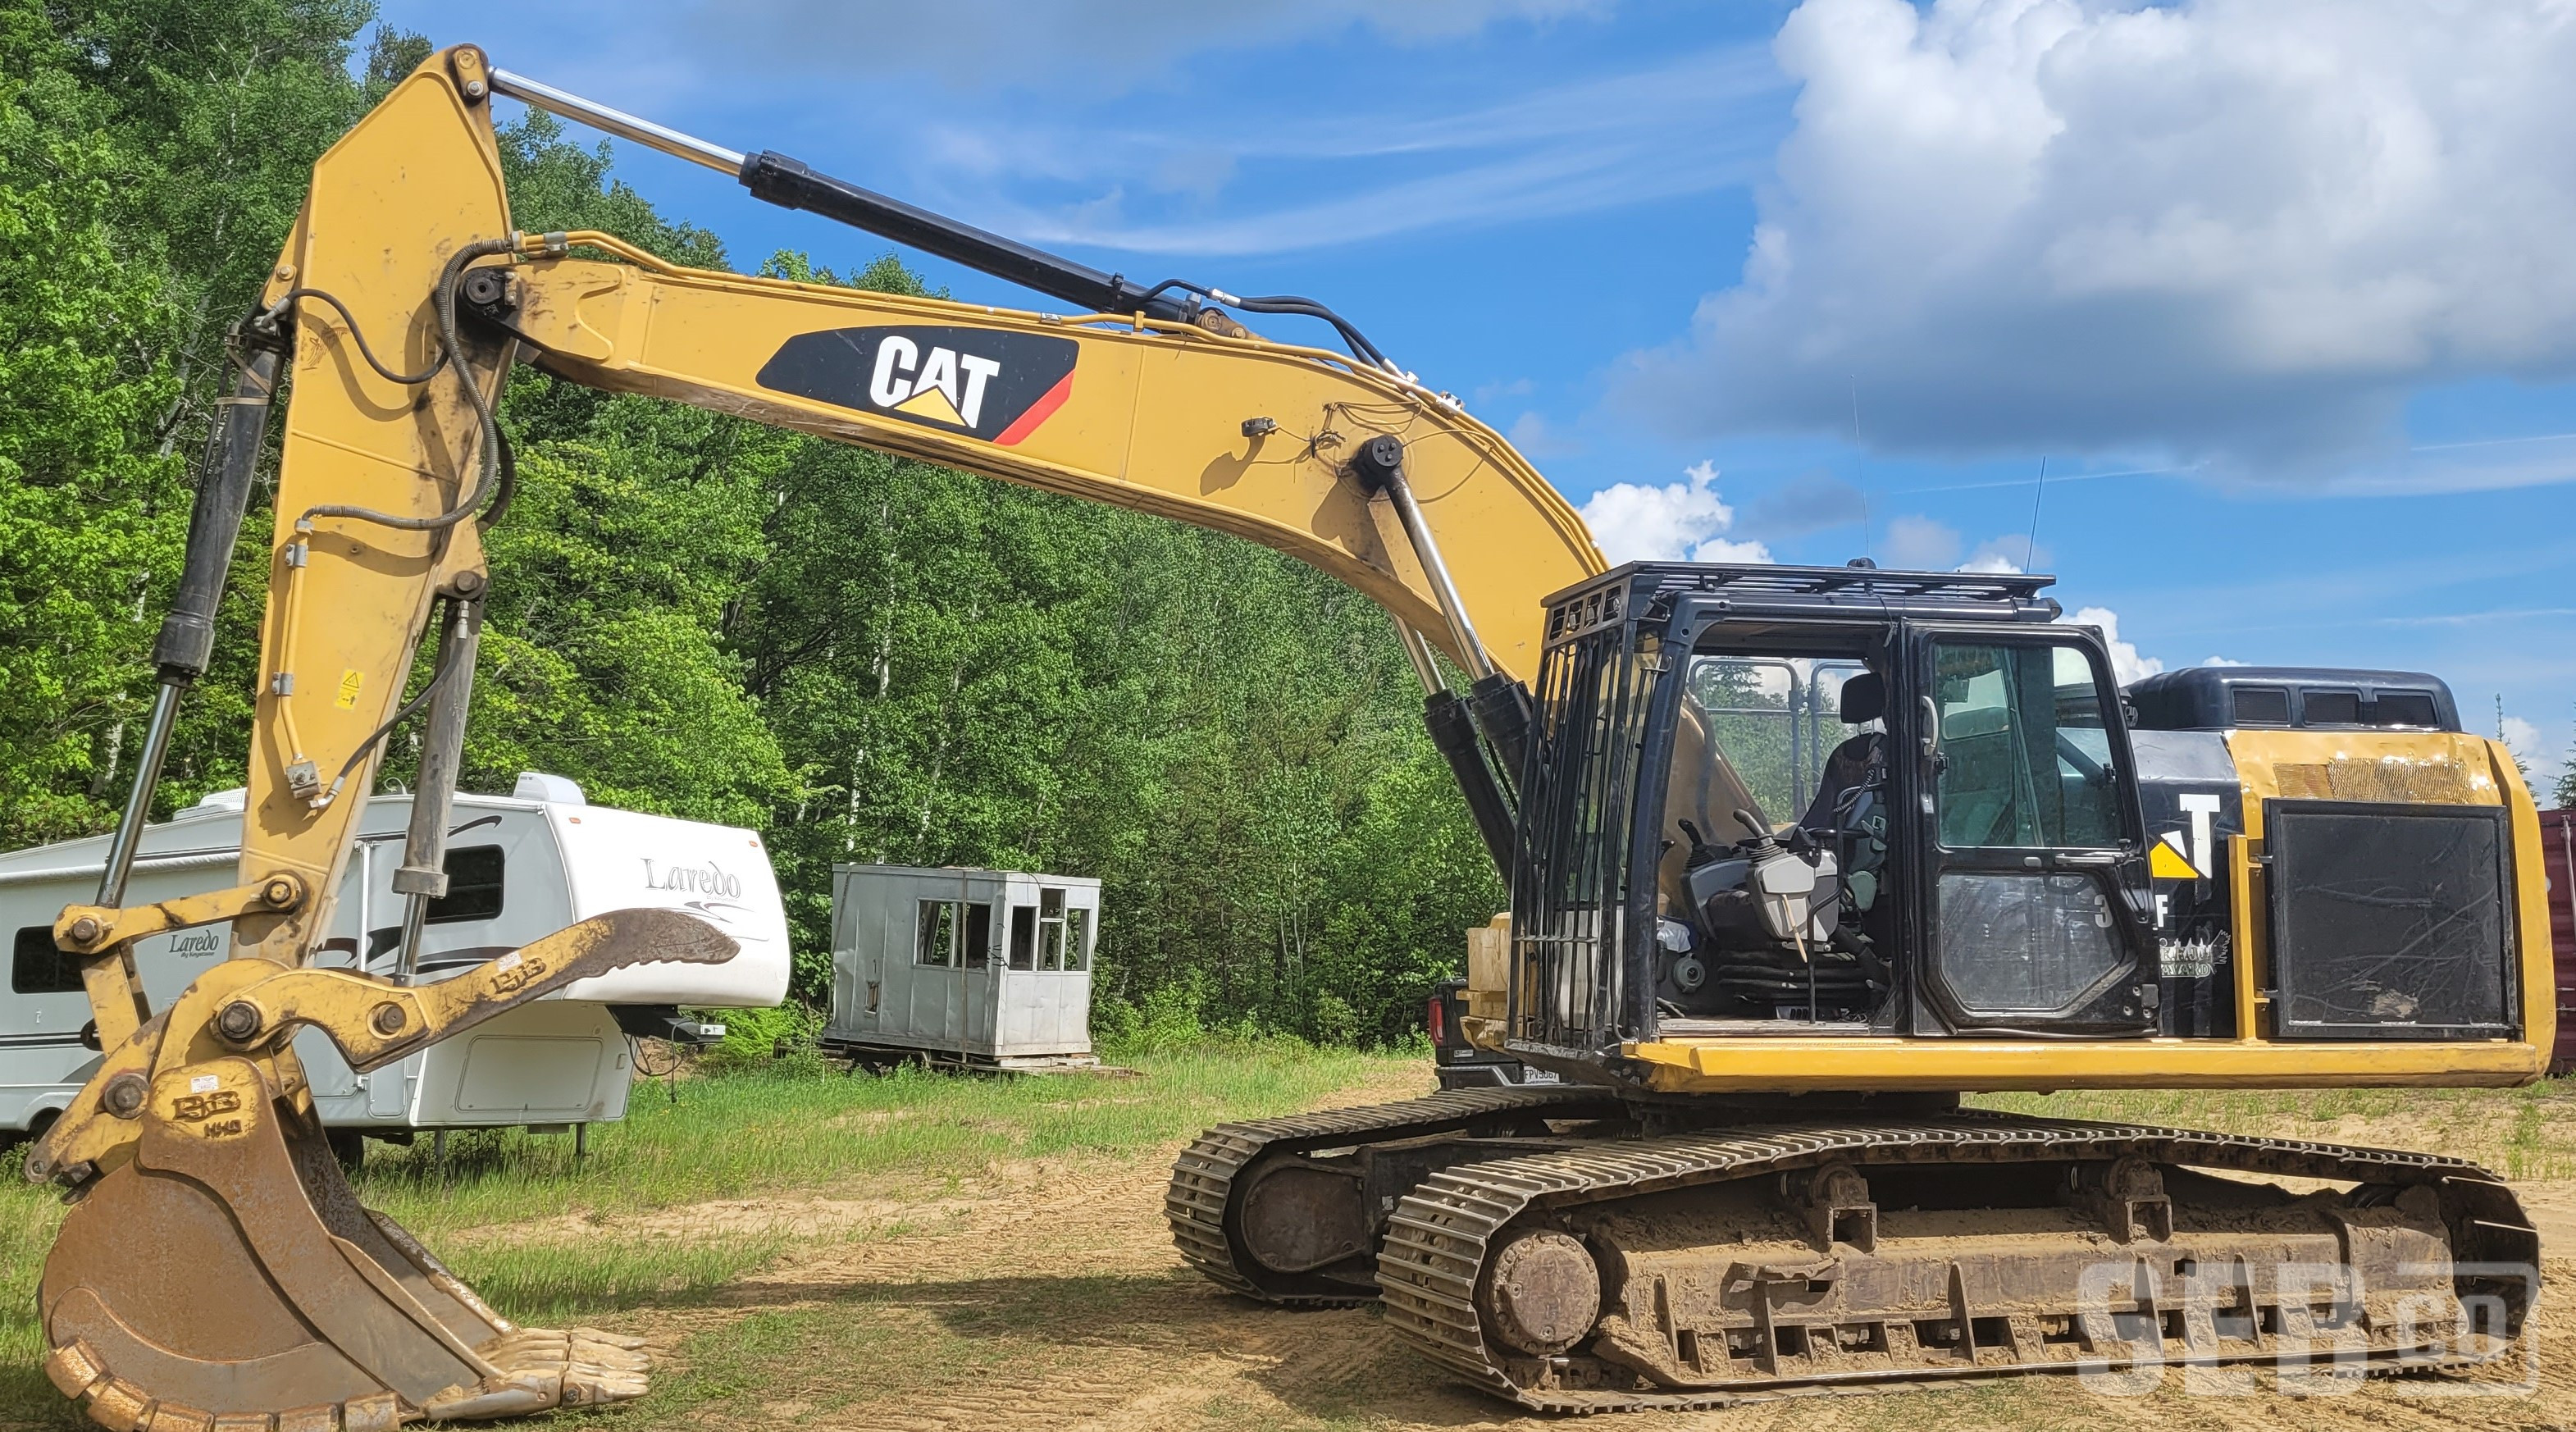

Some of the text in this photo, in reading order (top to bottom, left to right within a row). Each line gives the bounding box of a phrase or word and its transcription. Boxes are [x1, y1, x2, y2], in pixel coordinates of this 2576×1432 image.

[870, 335, 1001, 429] CAT
[640, 857, 741, 899] Laredo
[169, 929, 219, 952] Laredo
